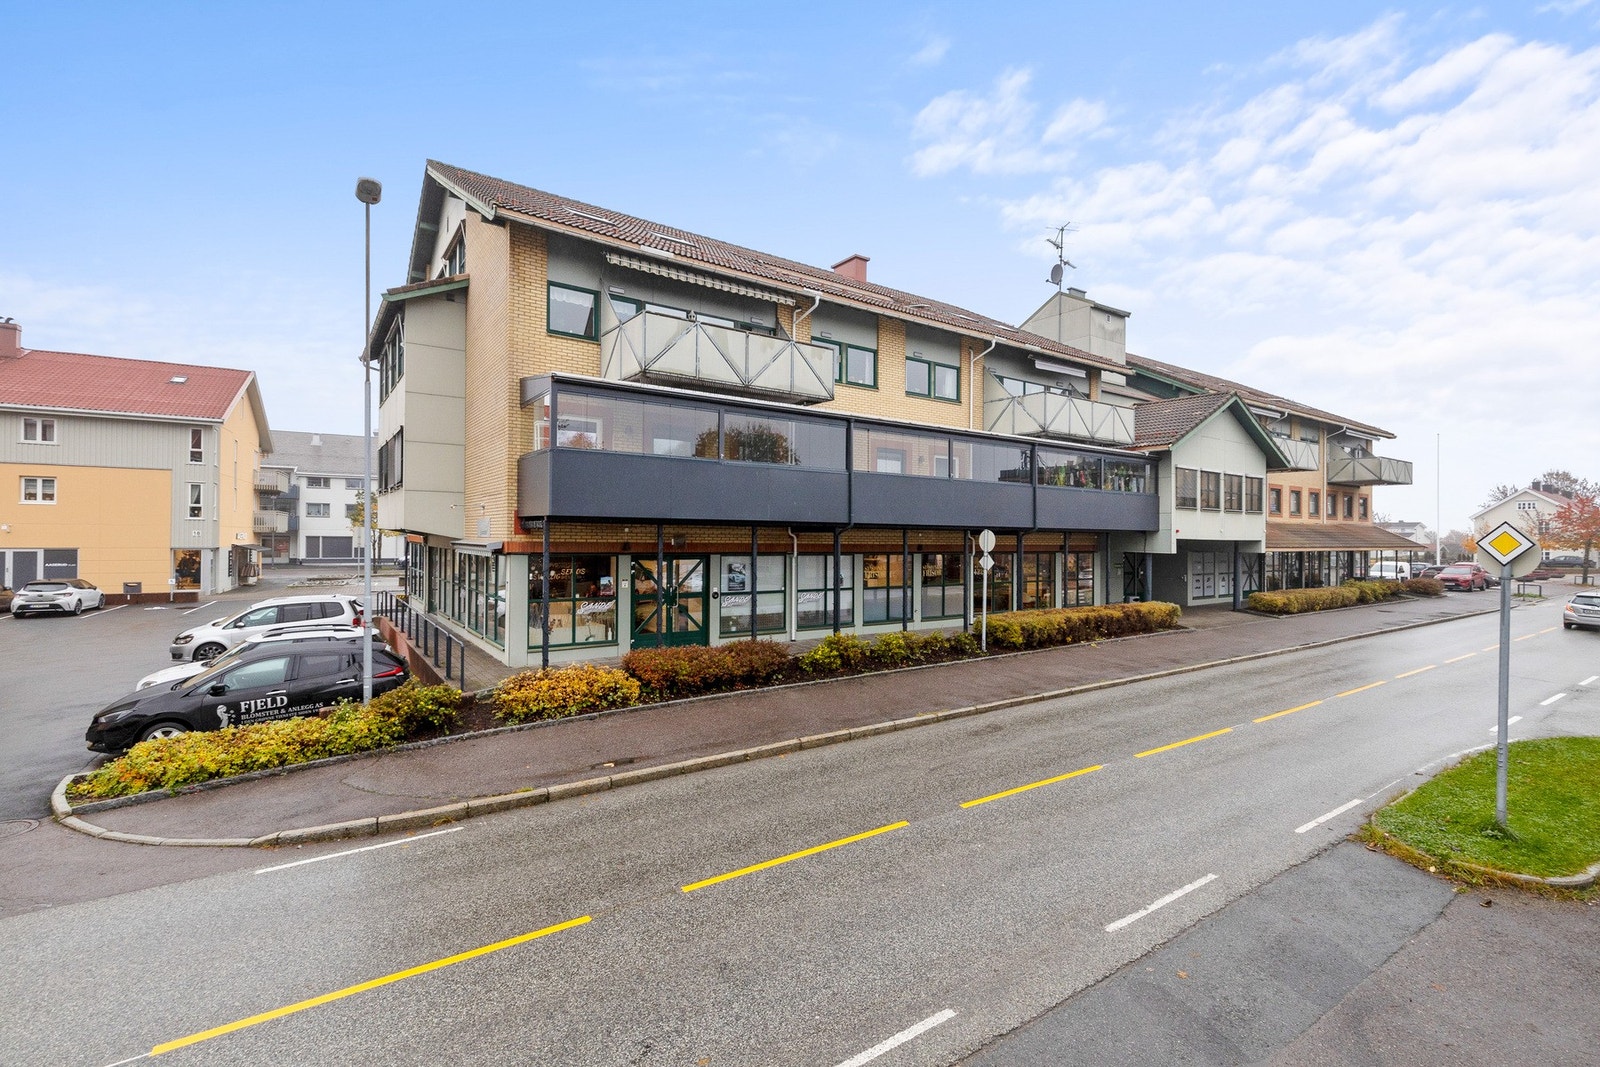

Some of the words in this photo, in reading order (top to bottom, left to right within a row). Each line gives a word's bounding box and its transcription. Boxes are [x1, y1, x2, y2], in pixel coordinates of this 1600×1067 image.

[240, 696, 288, 713] FJELD
[241, 709, 279, 720] BLOMSTER
[288, 703, 314, 712] ANLEGG
